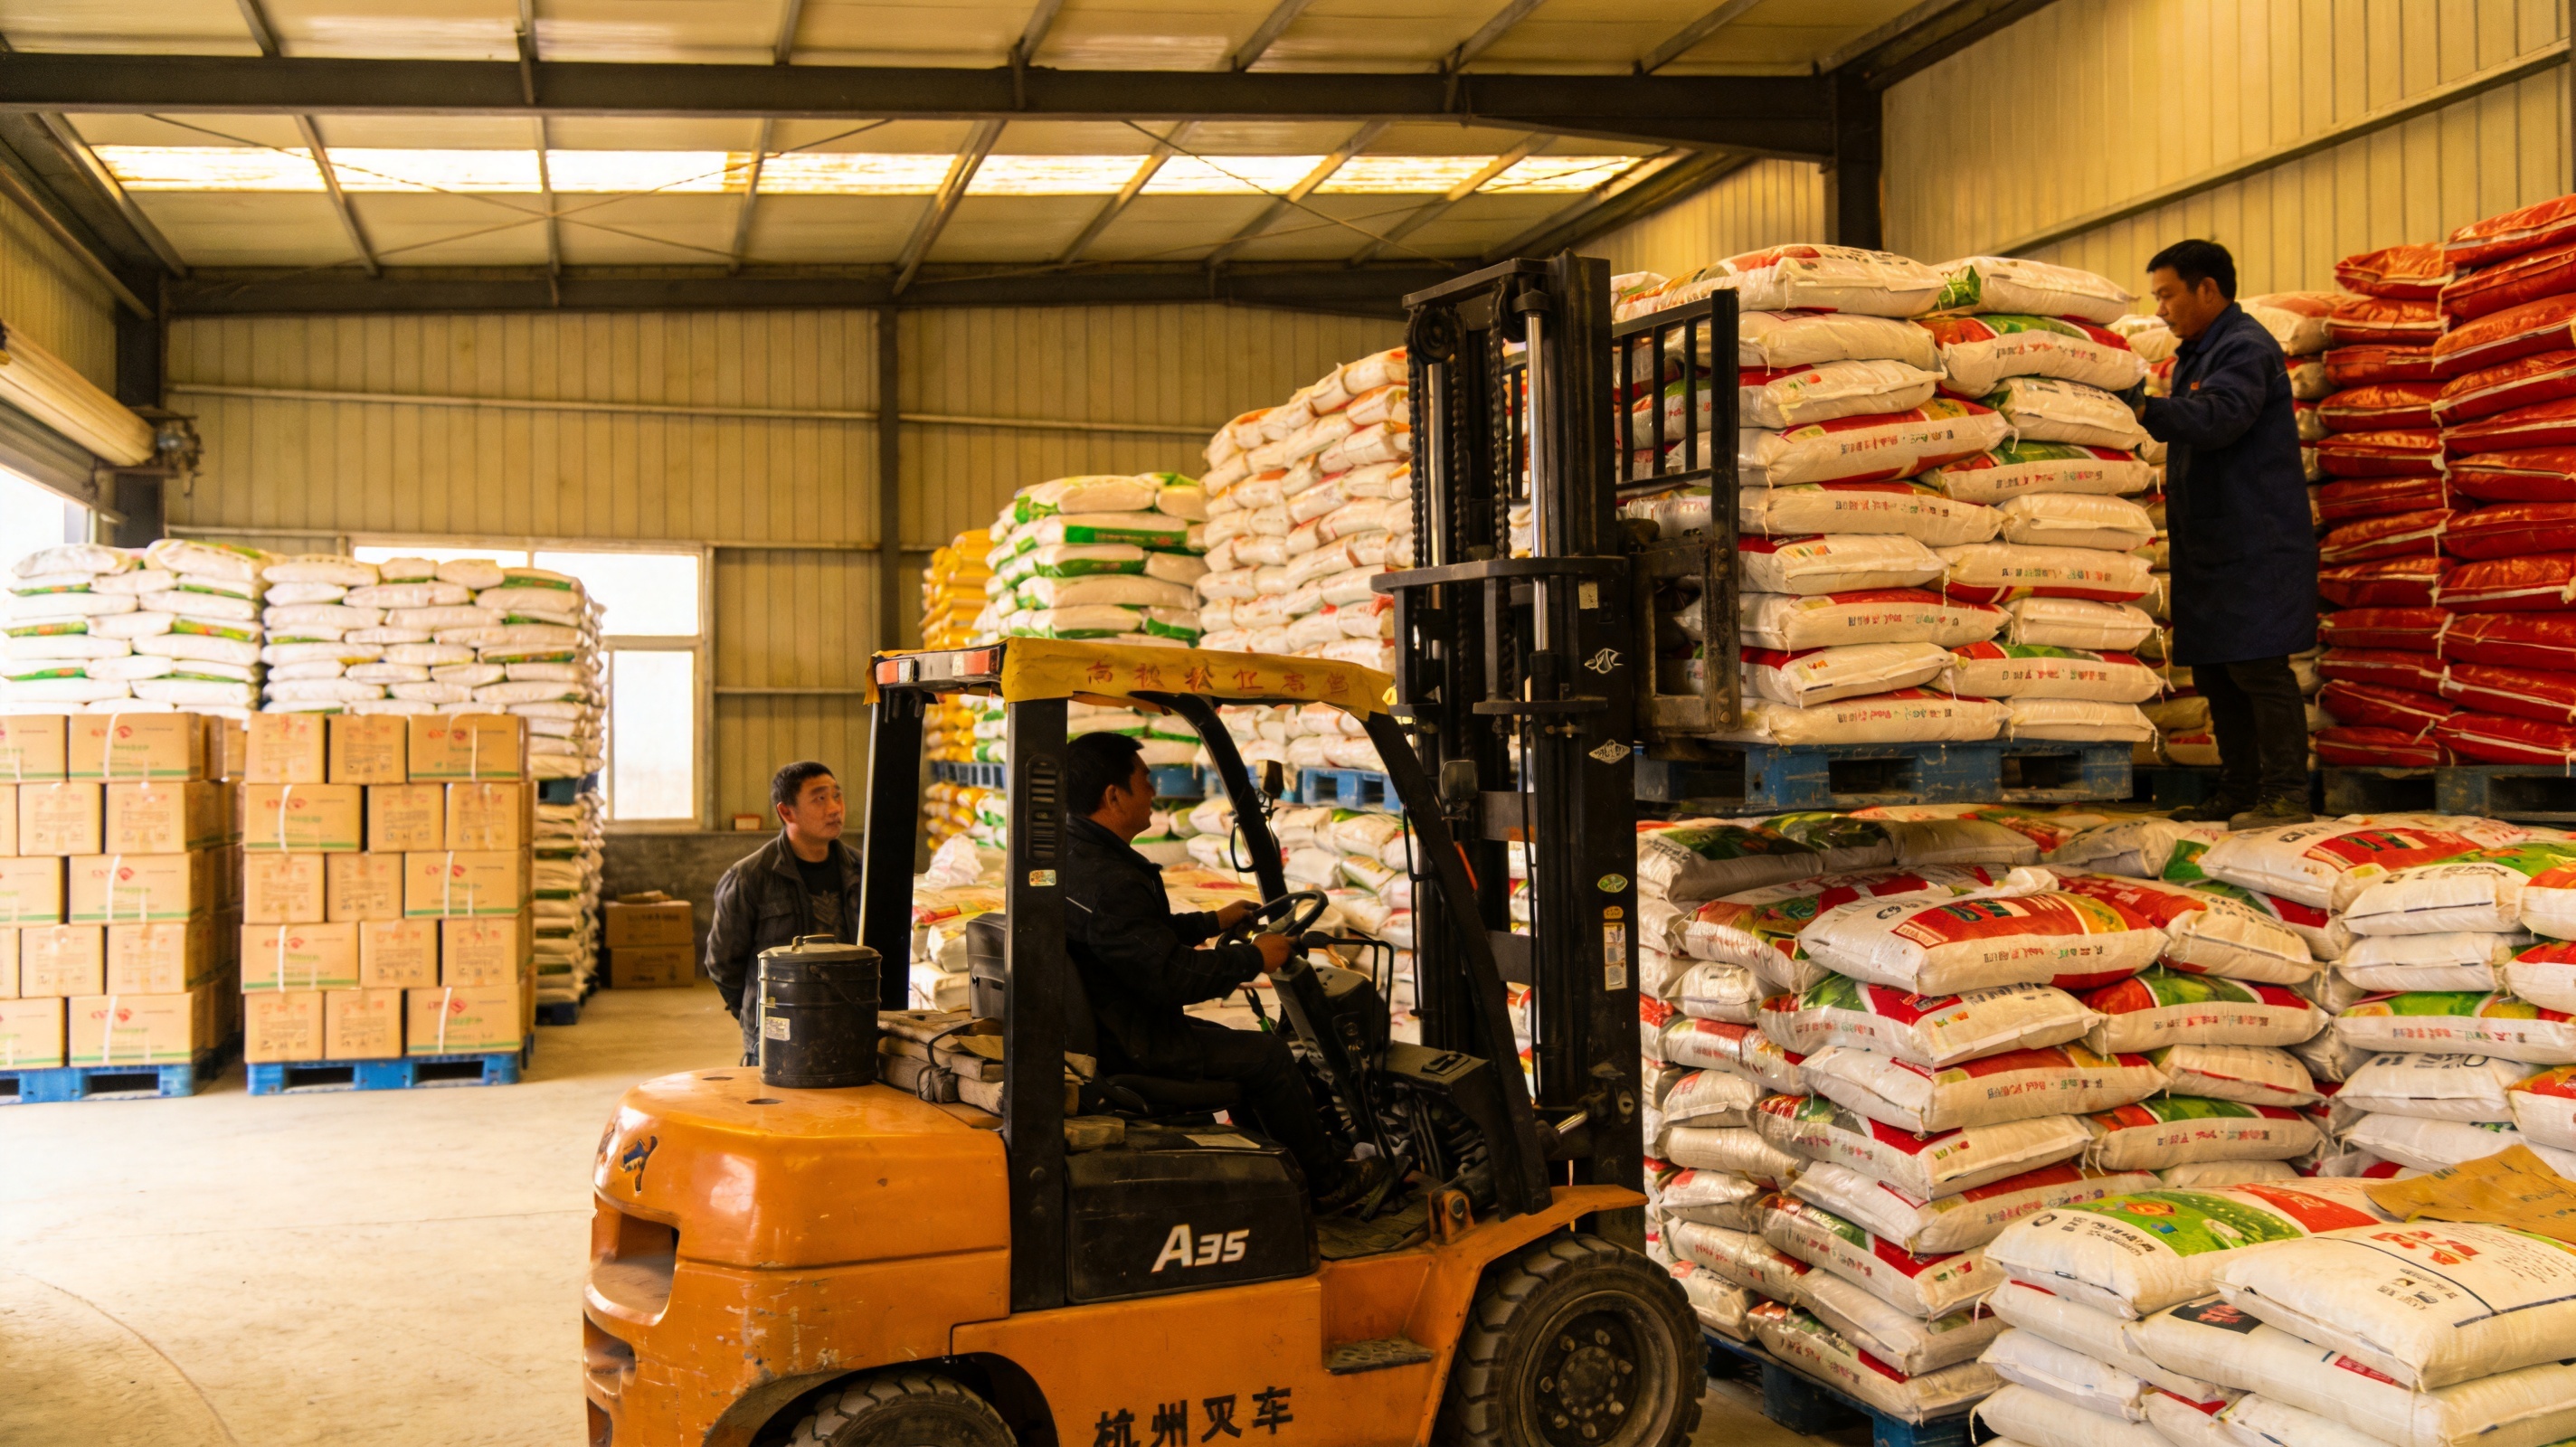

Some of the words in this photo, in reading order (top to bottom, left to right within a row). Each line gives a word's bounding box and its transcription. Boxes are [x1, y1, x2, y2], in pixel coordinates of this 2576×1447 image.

[1151, 1224, 1250, 1273] A35
[1093, 1386, 1293, 1447] 杭州叉车
